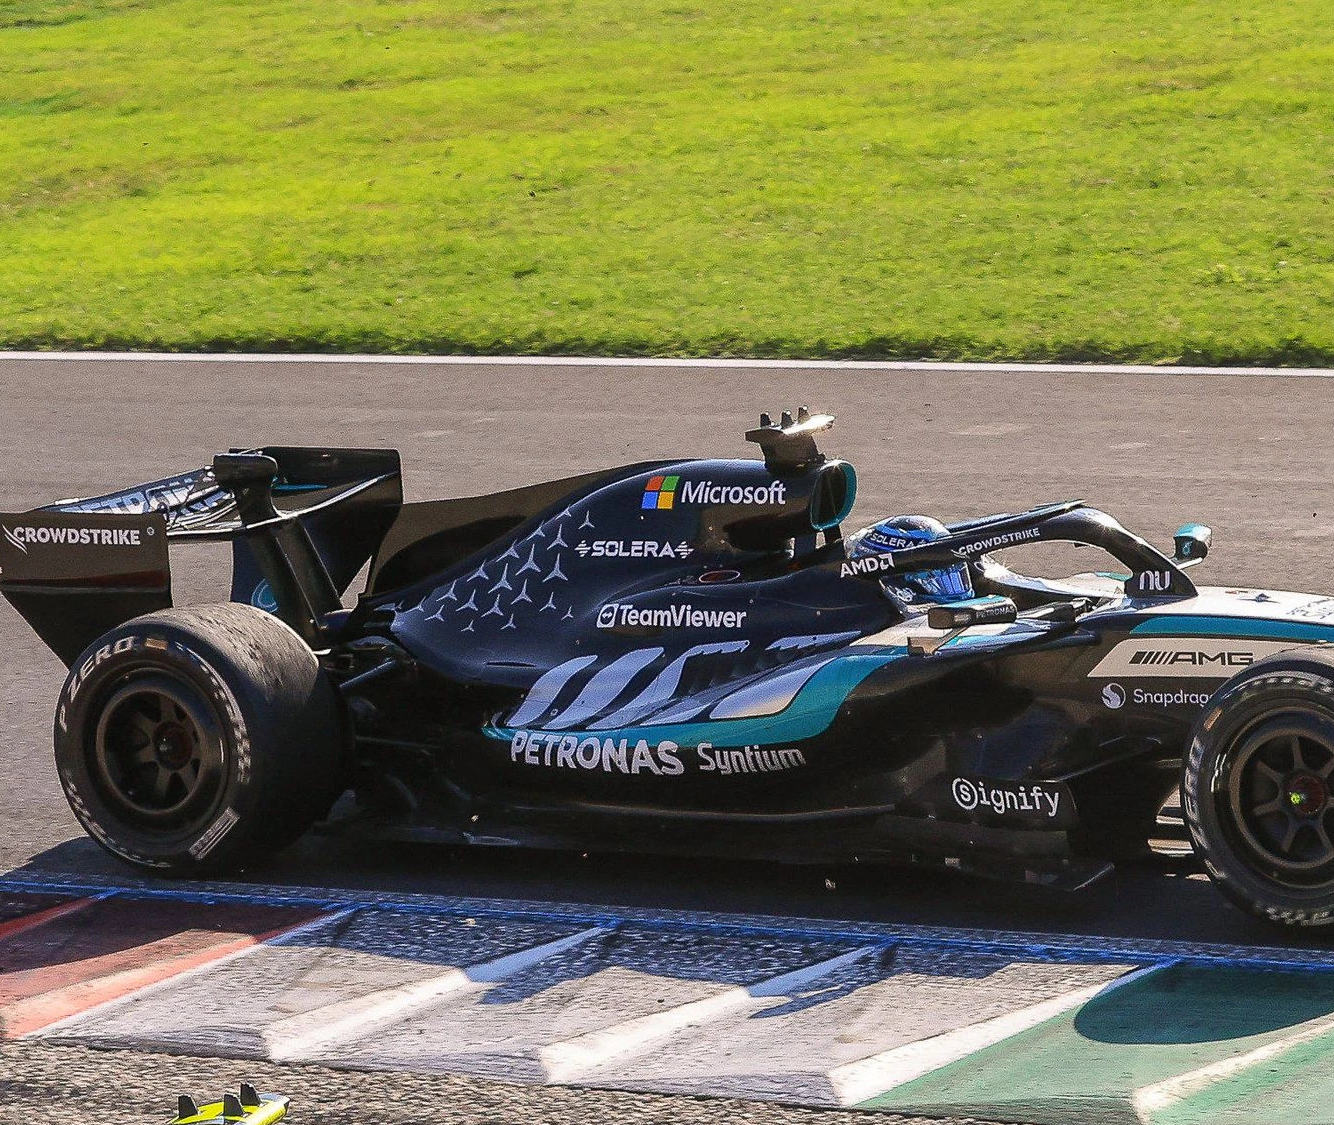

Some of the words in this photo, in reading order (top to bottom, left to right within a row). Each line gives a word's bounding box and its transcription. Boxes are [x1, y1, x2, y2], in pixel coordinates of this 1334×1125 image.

[681, 480, 786, 505] Microsoft
[13, 527, 141, 545] CROWDSTRIKE
[870, 533, 914, 548] SOLERA
[958, 528, 1041, 556] CROWDSTRIKE
[591, 541, 675, 558] SOLERA
[840, 557, 880, 579] AMD
[620, 604, 747, 628] TeamViewer
[1167, 651, 1255, 666] AMG
[511, 731, 685, 776] PETRONAS
[697, 742, 807, 776] Syntium
